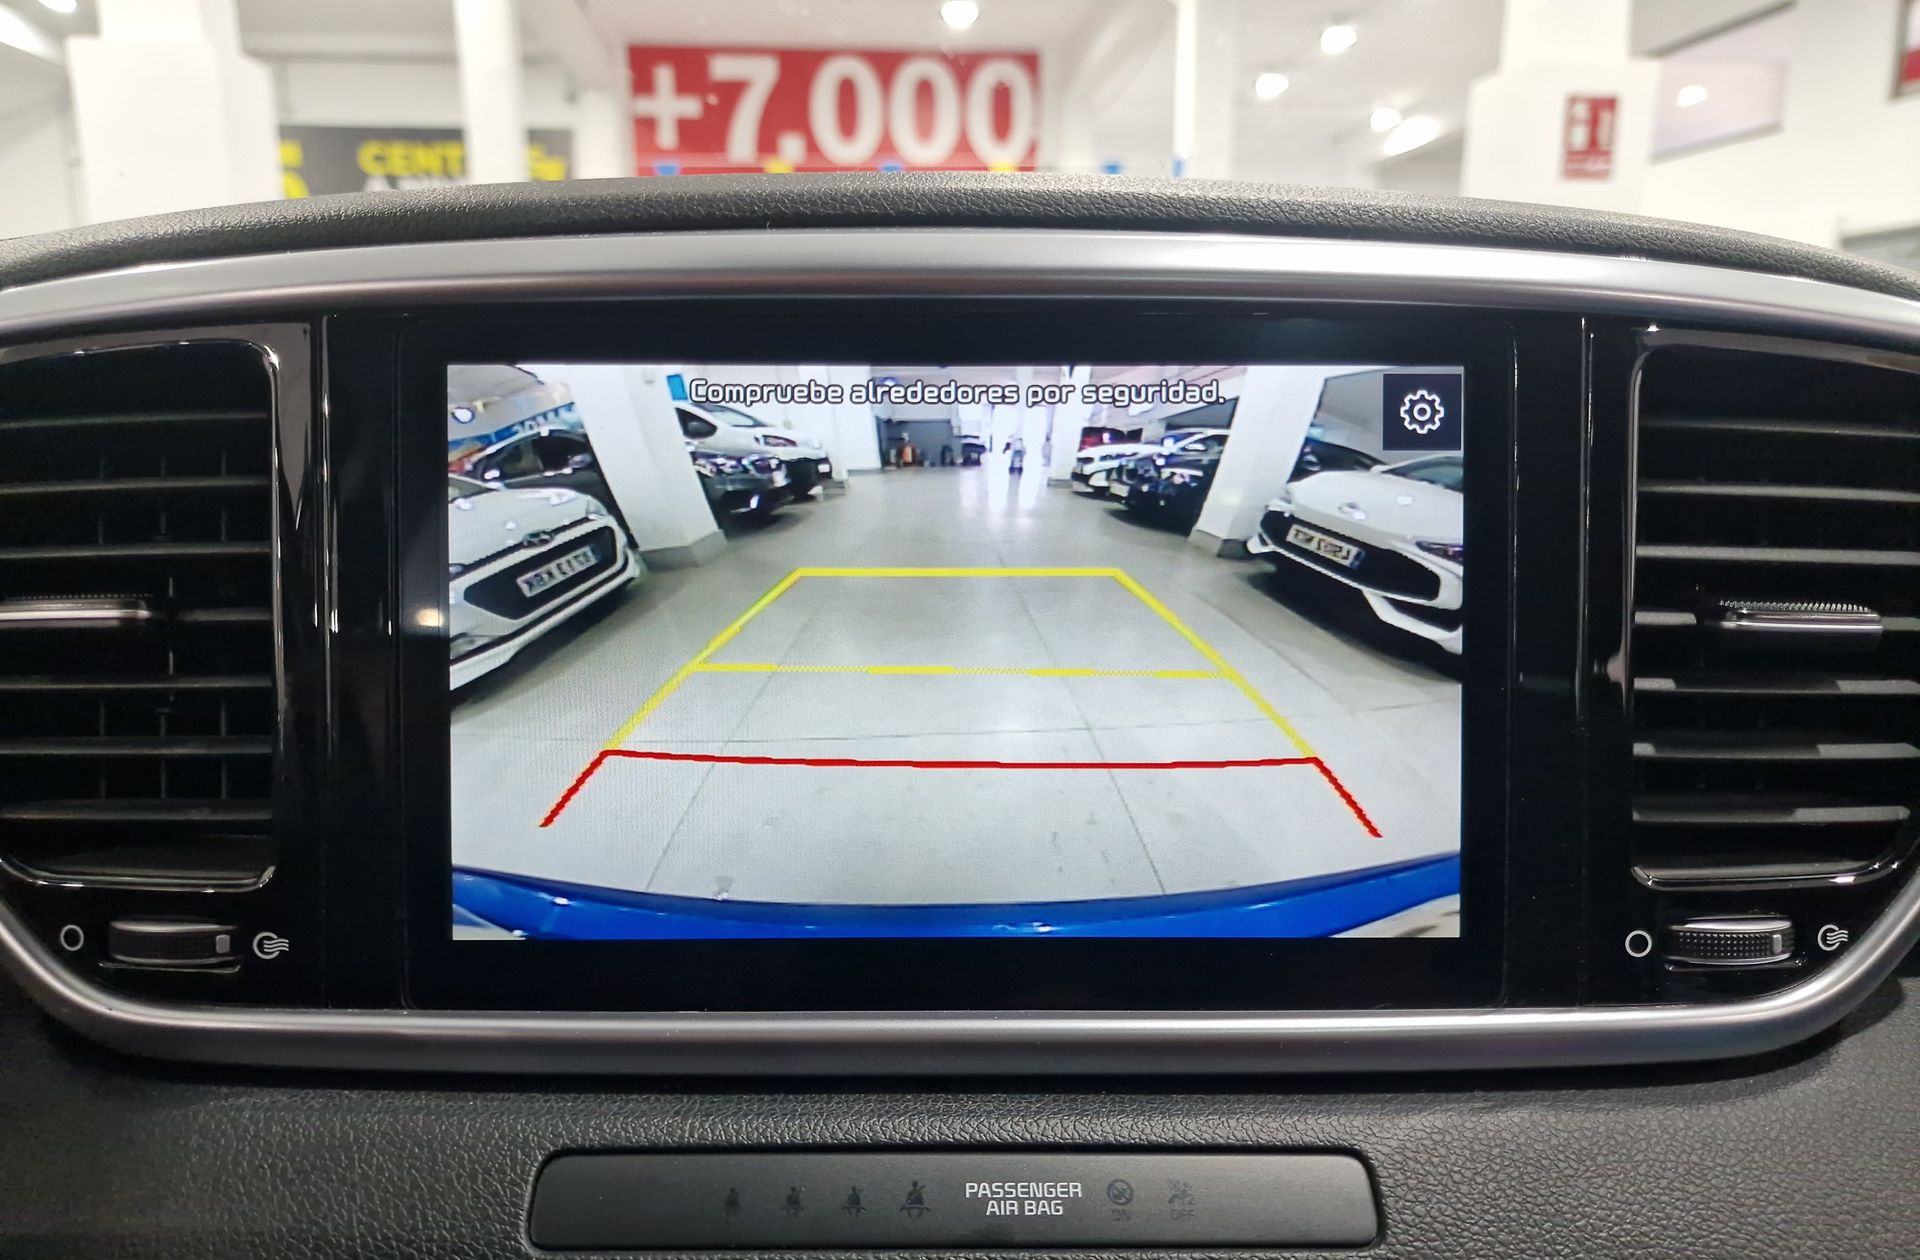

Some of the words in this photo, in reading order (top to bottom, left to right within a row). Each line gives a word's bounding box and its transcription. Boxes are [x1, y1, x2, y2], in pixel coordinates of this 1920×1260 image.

[635, 54, 1033, 166] +7.000
[690, 379, 843, 407] Compruebe
[850, 380, 1020, 405] alrededores
[1025, 384, 1075, 408] por
[1081, 379, 1226, 408] seguridad.
[965, 1182, 1082, 1199] PASSENGER
[985, 1200, 1019, 1216] AIR
[1023, 1200, 1064, 1216] BAG
